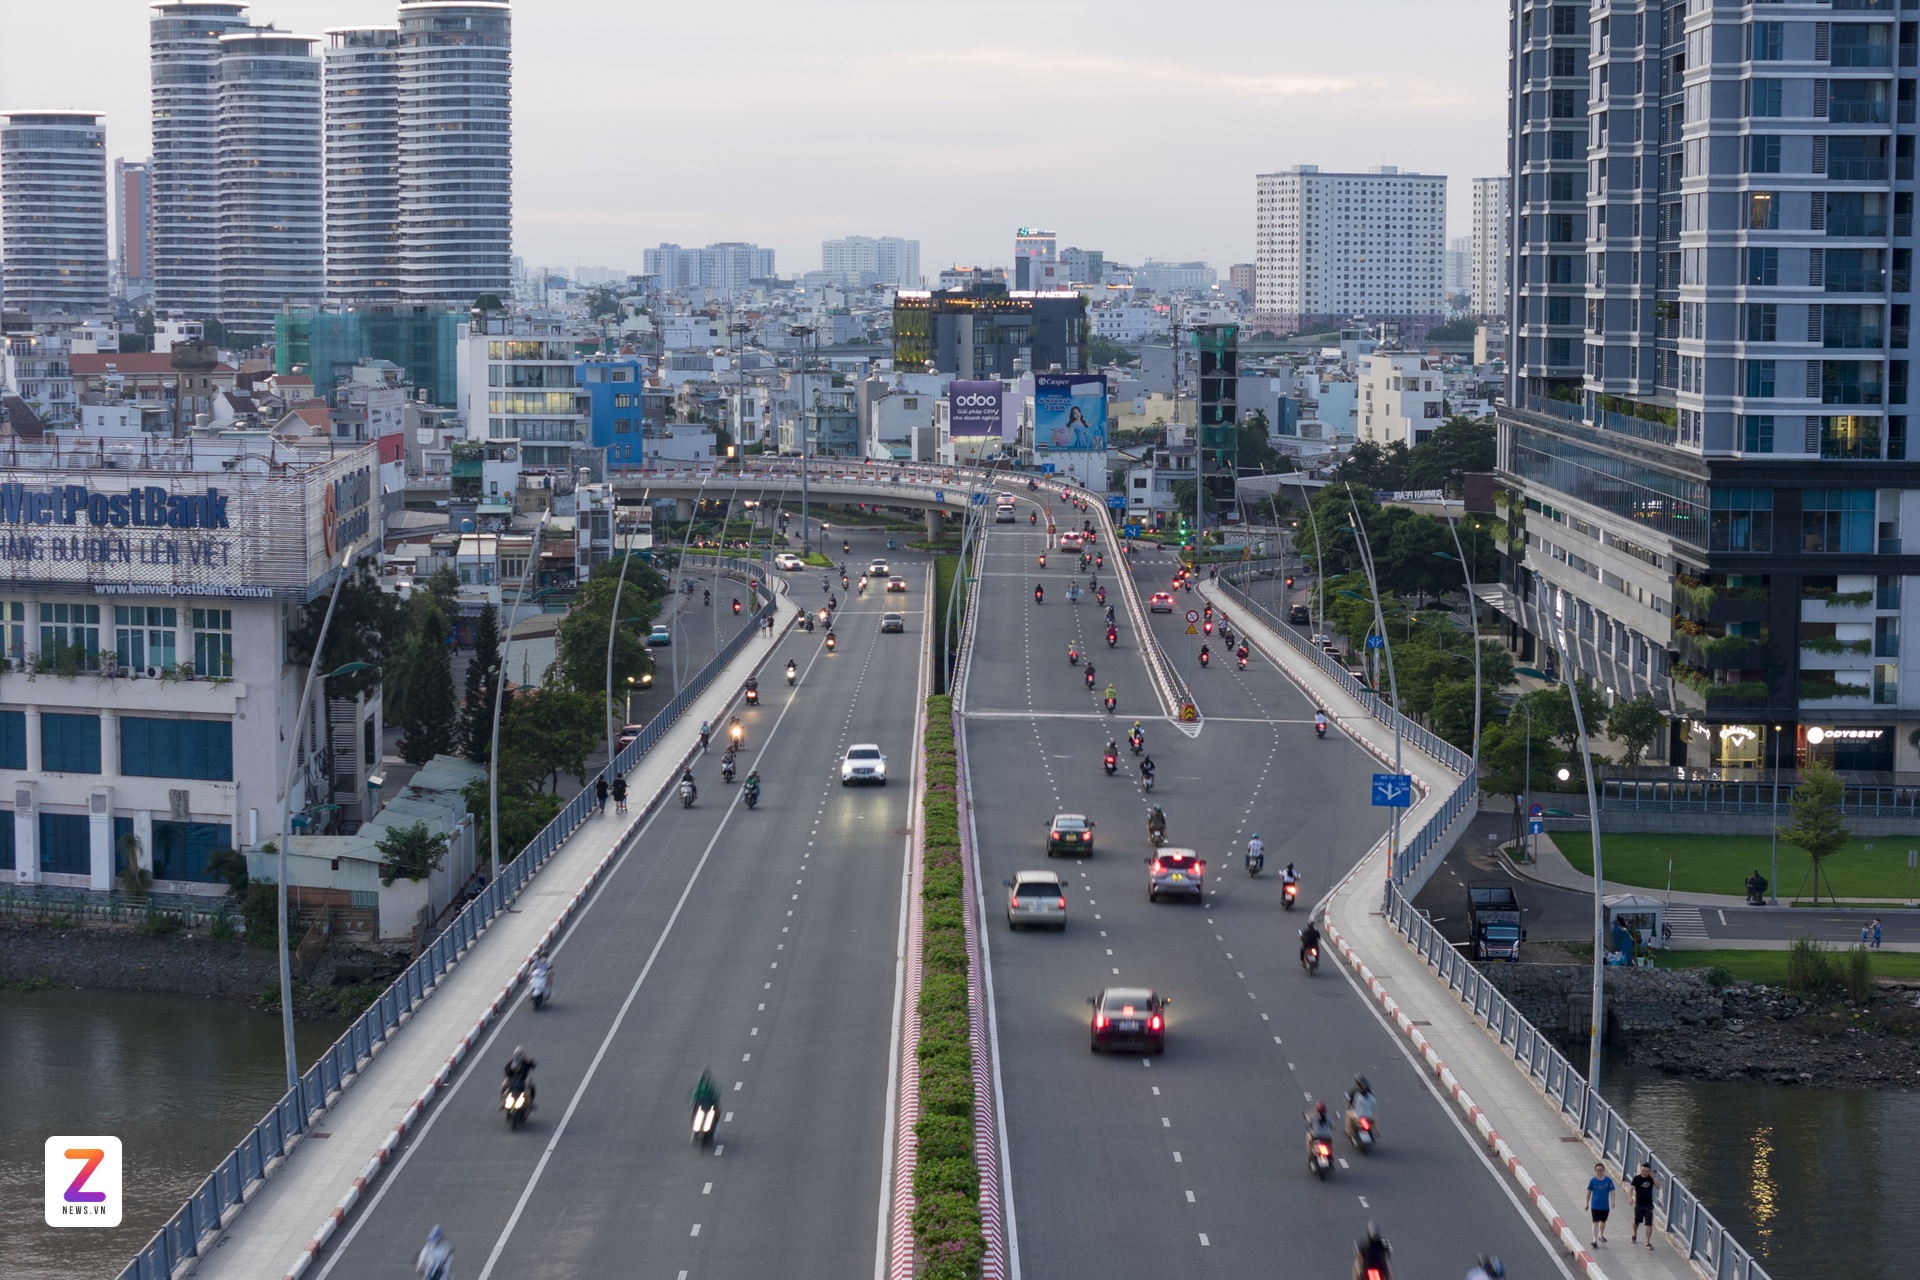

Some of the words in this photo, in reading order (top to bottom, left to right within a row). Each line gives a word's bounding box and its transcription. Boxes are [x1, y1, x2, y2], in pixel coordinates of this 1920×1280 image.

[1046, 378, 1070, 386] Casper
[956, 393, 996, 407] odoo
[0, 483, 230, 529] VietPostBank
[140, 533, 179, 565] LIÊN
[95, 582, 273, 598] www.lienvietpostbank.com.vn
[1824, 730, 1884, 738] ODYSSEY
